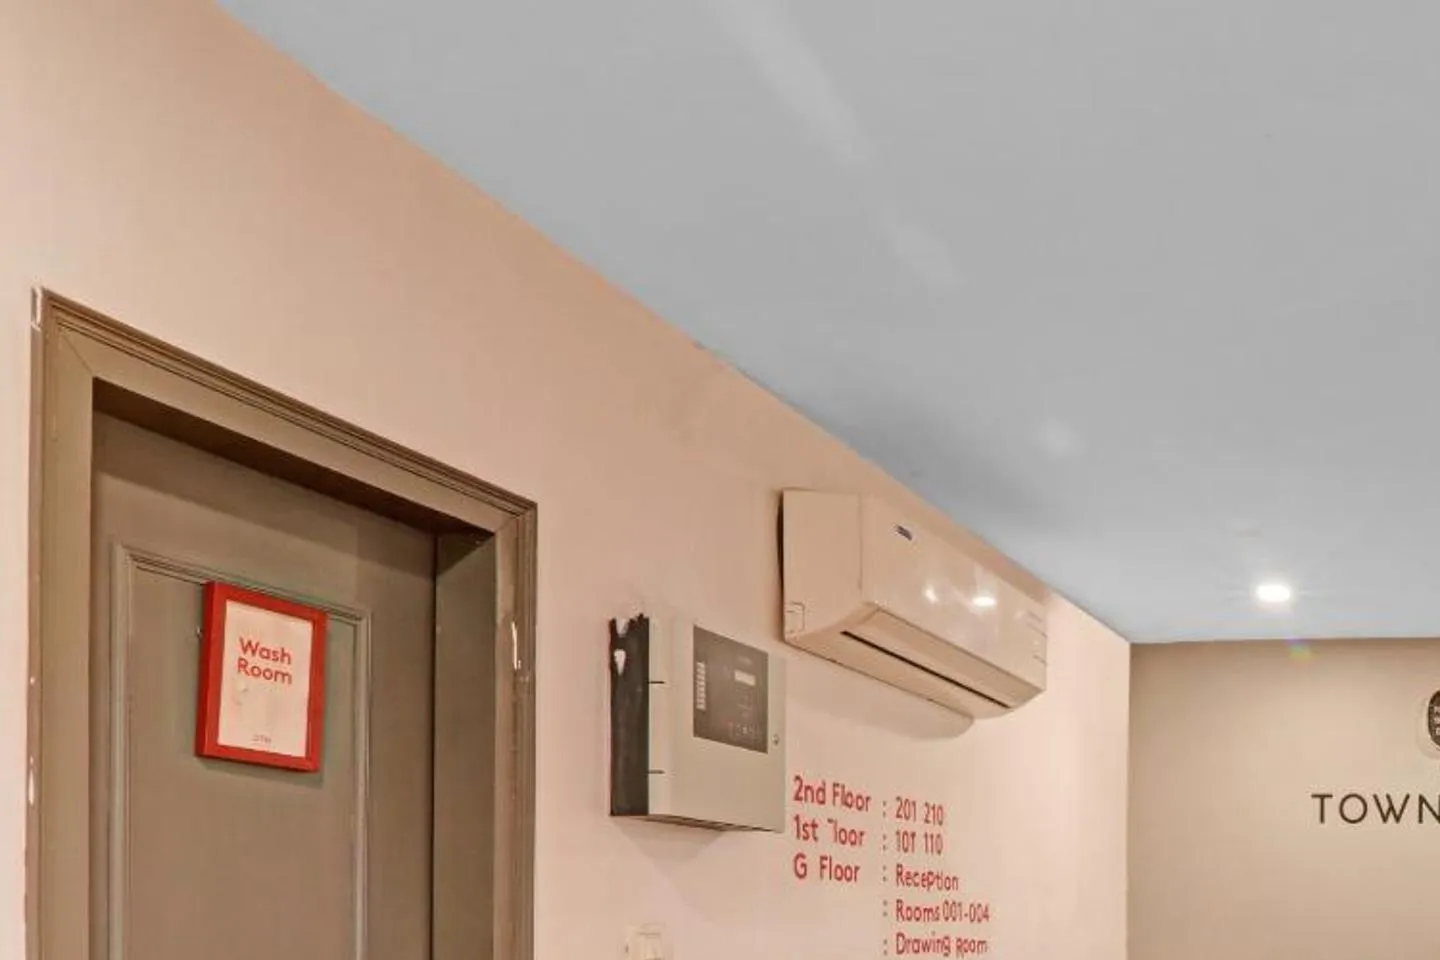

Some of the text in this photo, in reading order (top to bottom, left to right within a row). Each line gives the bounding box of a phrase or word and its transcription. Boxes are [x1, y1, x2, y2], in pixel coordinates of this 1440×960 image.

[238, 636, 292, 665] Wash
[236, 657, 293, 685] Room
[794, 774, 826, 806] 2nd
[832, 782, 872, 813] Floor
[896, 796, 917, 822] 201
[923, 801, 944, 827] 210
[793, 813, 819, 843] 1st
[895, 830, 917, 854] 101
[923, 831, 944, 856] 110
[793, 851, 808, 880] G
[819, 855, 861, 882] Floor
[896, 863, 960, 892] Reception
[896, 898, 940, 922] Rooms
[942, 899, 990, 924] 001-004
[896, 930, 951, 958] Drawing
[955, 937, 988, 959] Room
